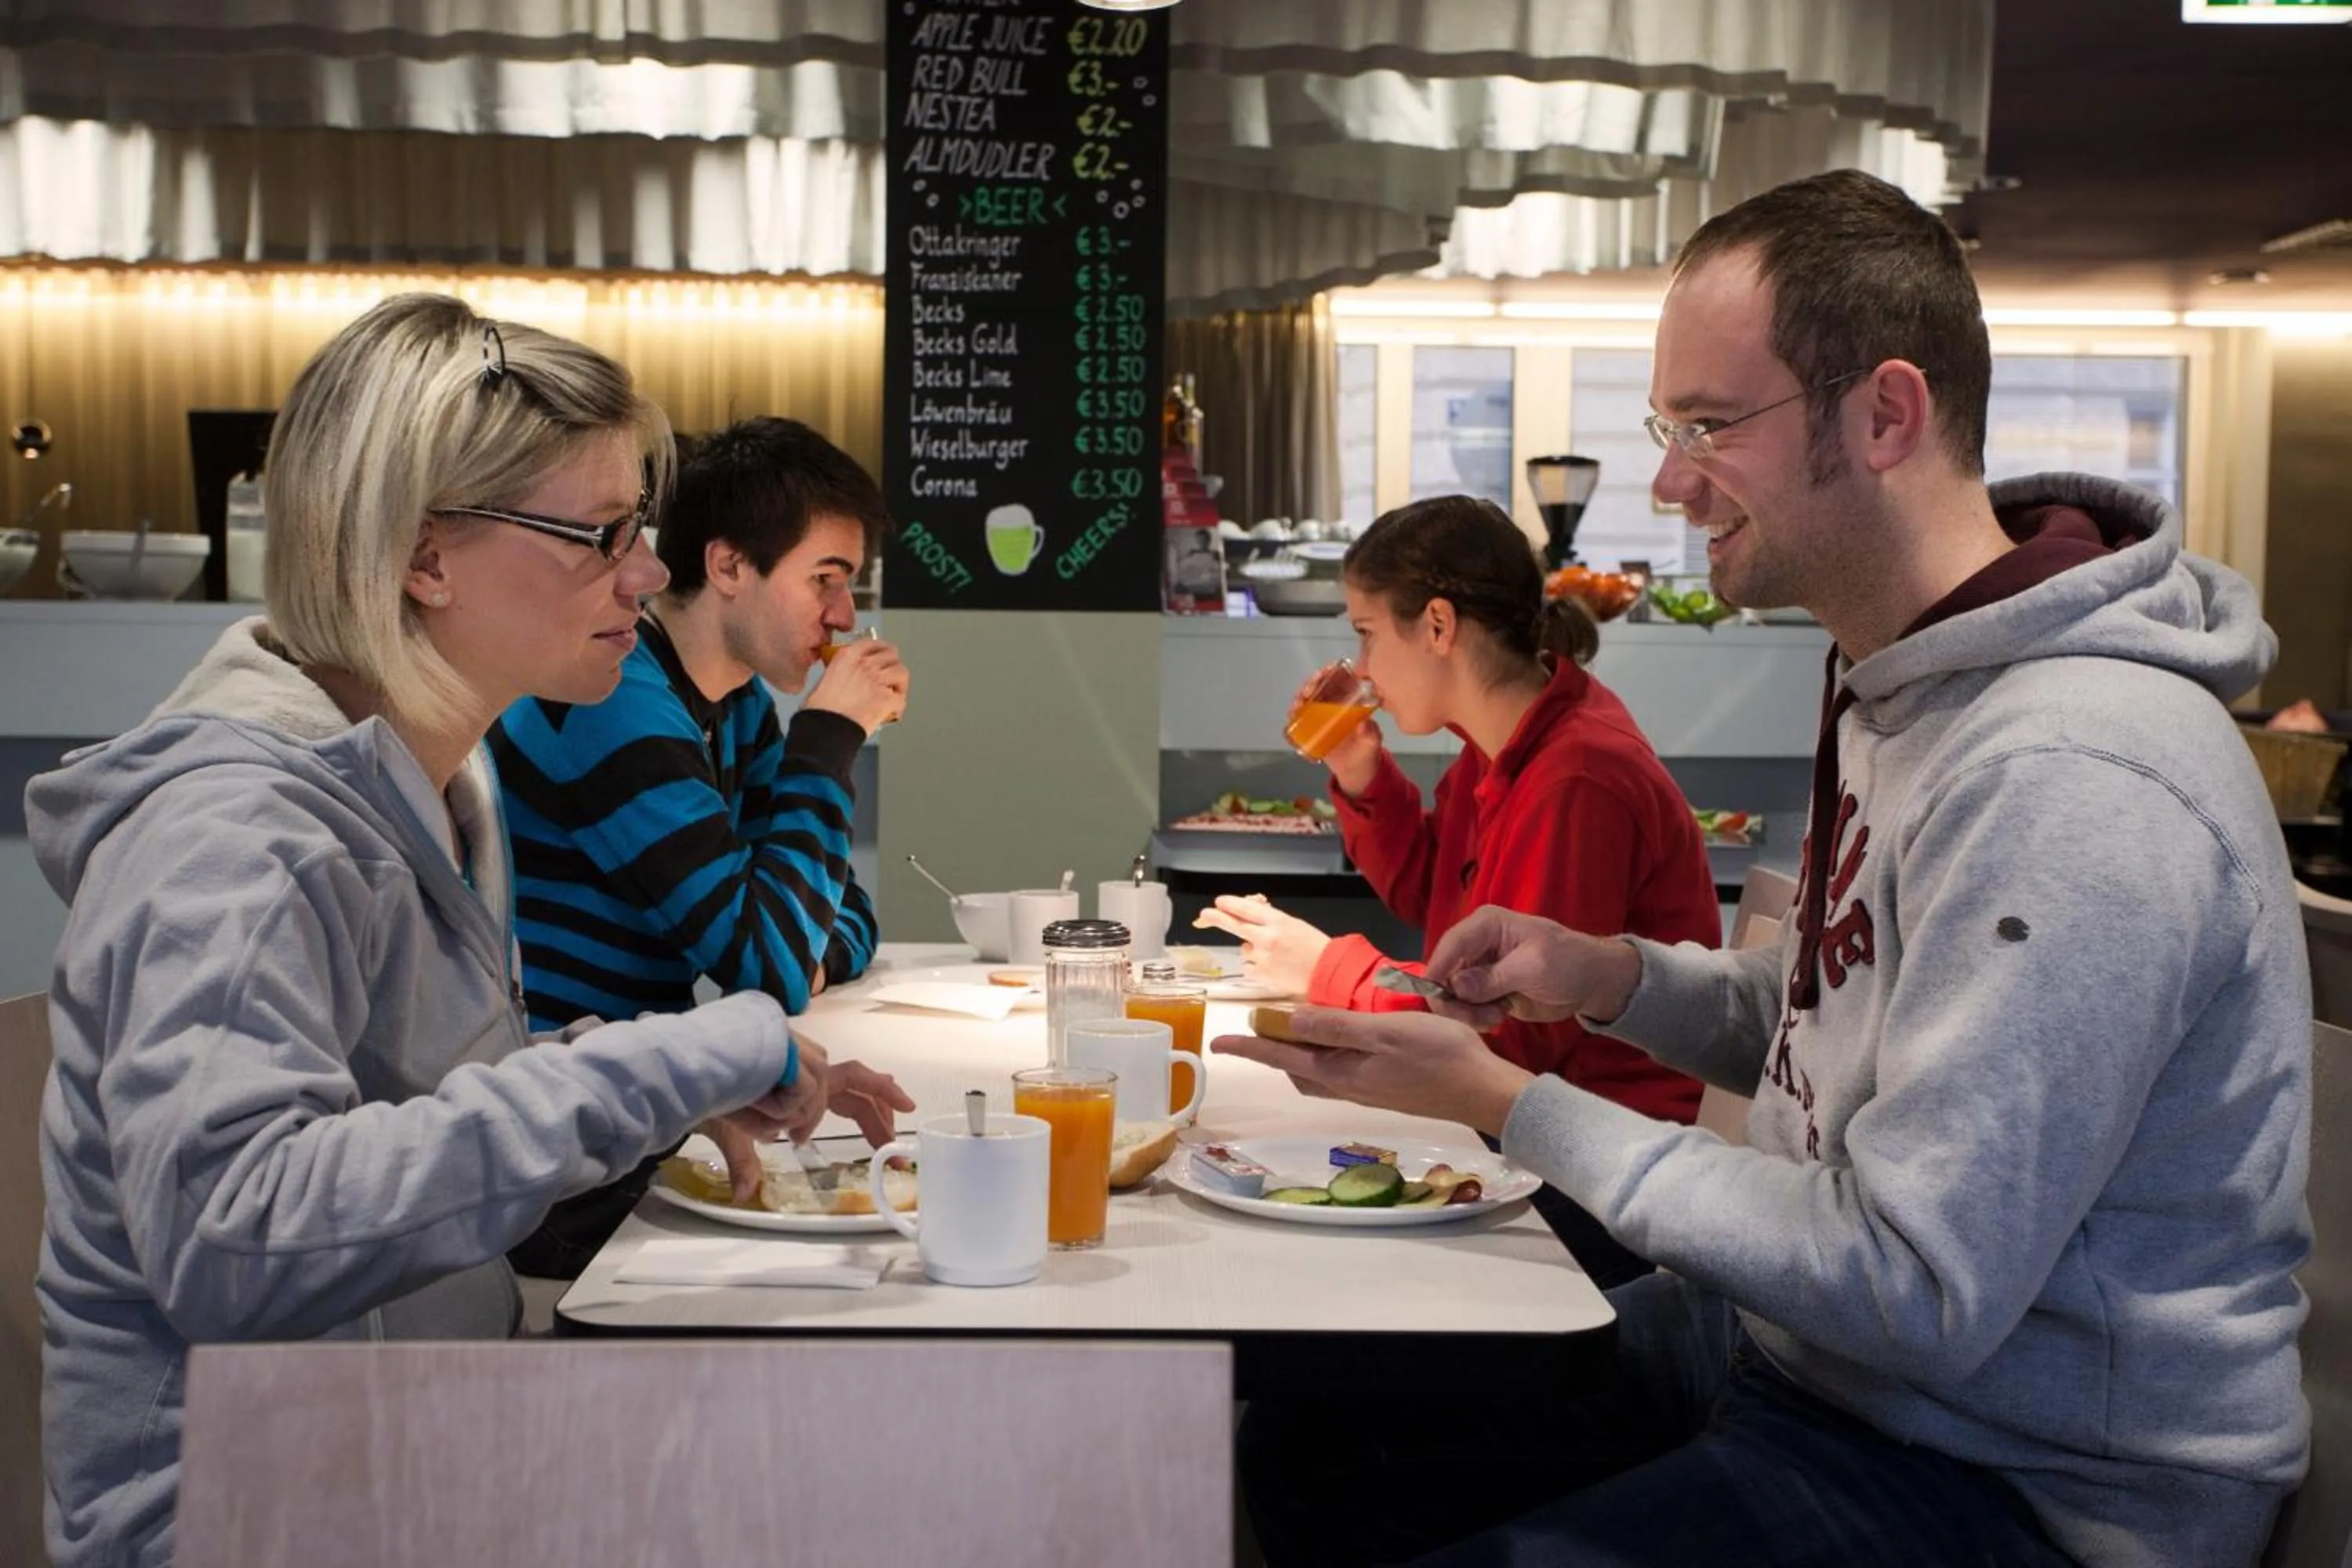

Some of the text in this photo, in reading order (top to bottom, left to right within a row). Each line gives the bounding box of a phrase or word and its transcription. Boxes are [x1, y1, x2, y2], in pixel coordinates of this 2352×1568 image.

[911, 13, 978, 50] APPLE
[982, 15, 1054, 55] JUICE
[911, 54, 964, 90] RED
[969, 56, 1028, 95] BULL
[904, 91, 996, 131] NESTEA
[904, 136, 1054, 180] ALMDUDLER
[909, 224, 1021, 269] Ottakringer
[912, 295, 965, 325] Becks
[913, 327, 965, 355] Becks
[971, 323, 1018, 354] Gold
[913, 360, 964, 387] Becks
[970, 358, 1011, 387] Lime
[910, 394, 1012, 424] Löwenbräu
[910, 427, 1029, 470] Wieselburger
[910, 465, 978, 497] Corona
[902, 521, 972, 593] PROST!
